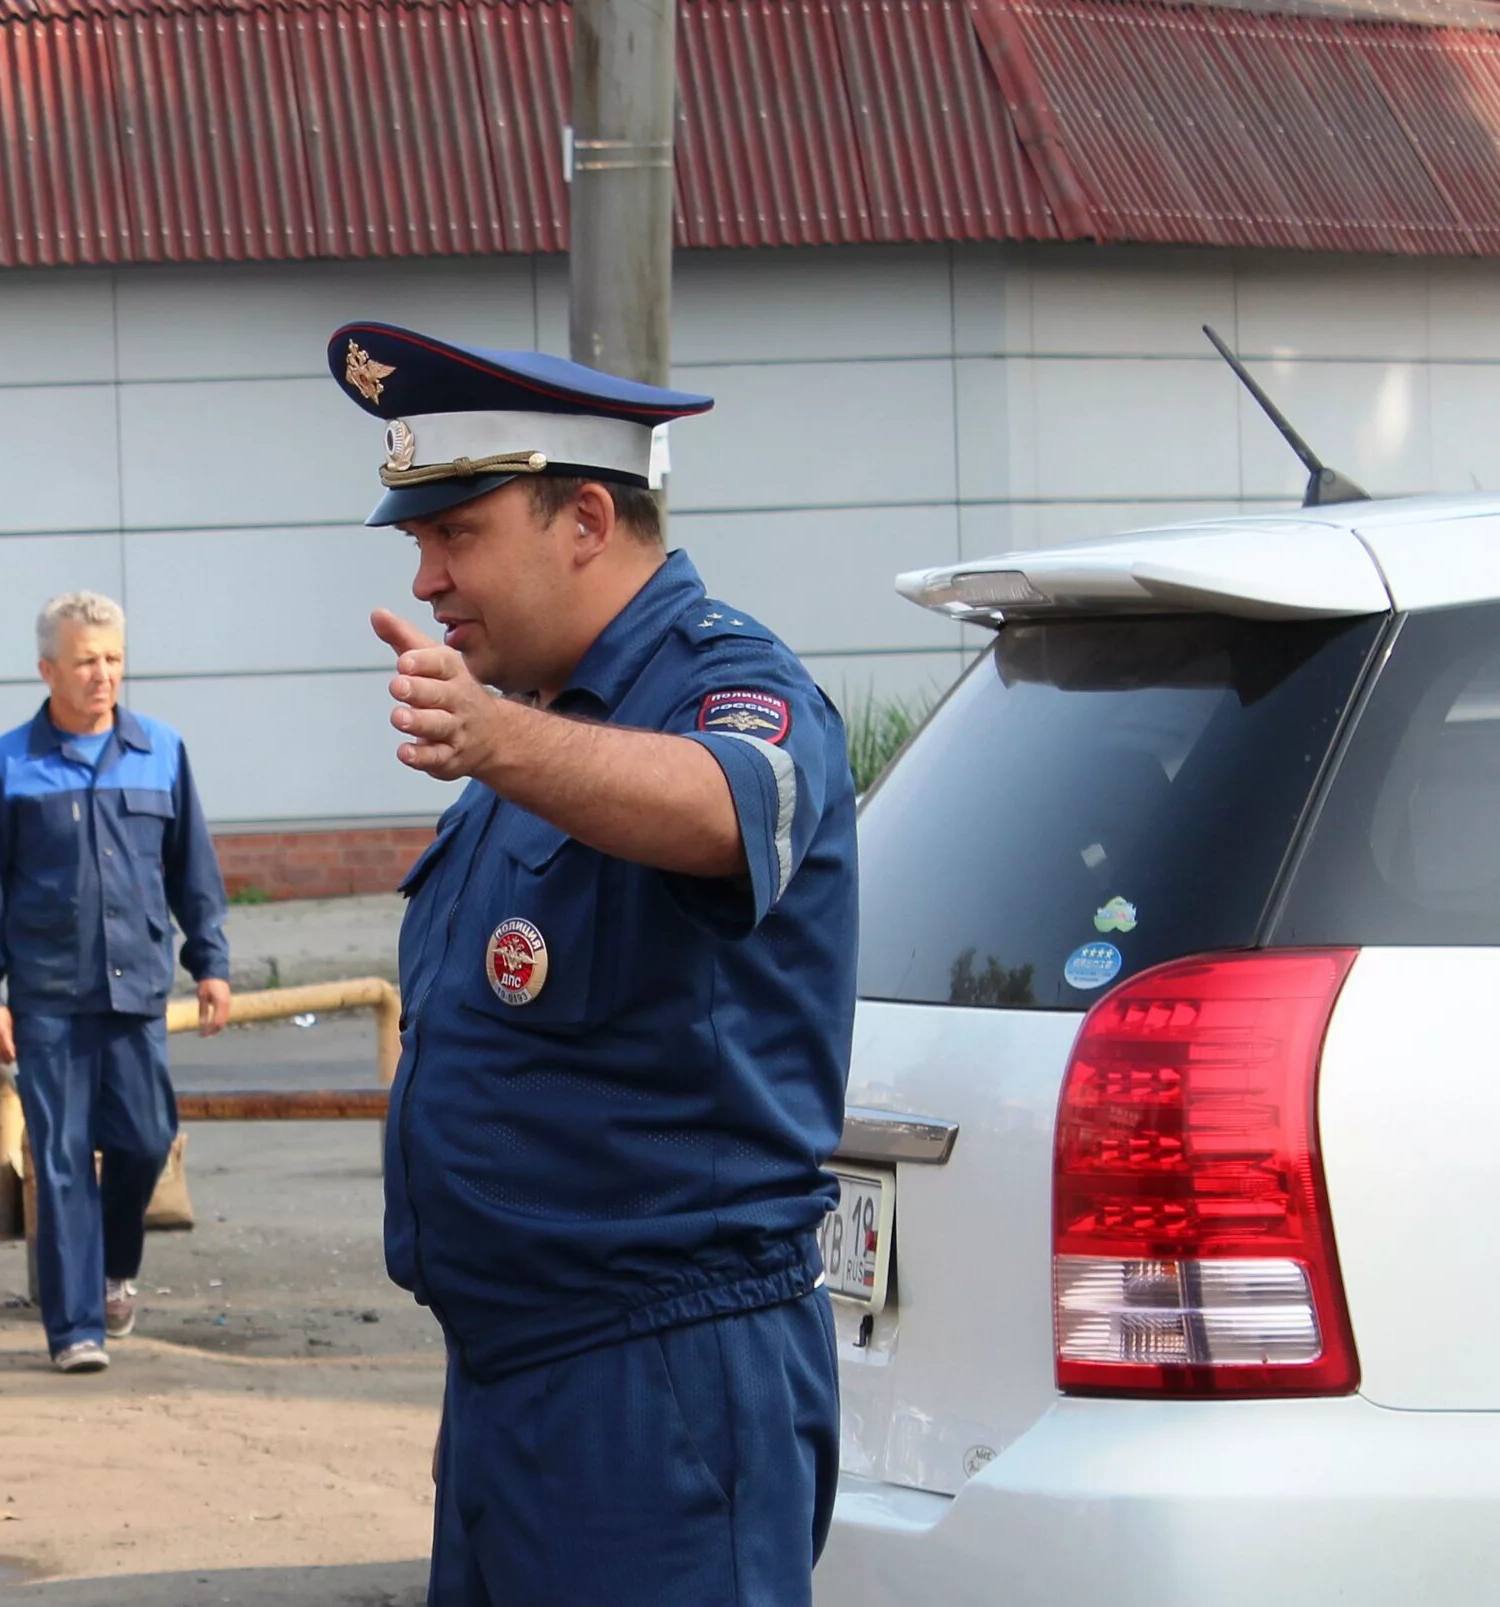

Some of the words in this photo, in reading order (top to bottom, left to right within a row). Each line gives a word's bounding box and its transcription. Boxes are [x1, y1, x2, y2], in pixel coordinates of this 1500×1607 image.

[711, 692, 781, 707] ПОЛИЦИЯ
[495, 921, 541, 949] ПОЛИЦИЯ
[501, 972, 521, 988] ДПС
[846, 1259, 864, 1283] RUS
